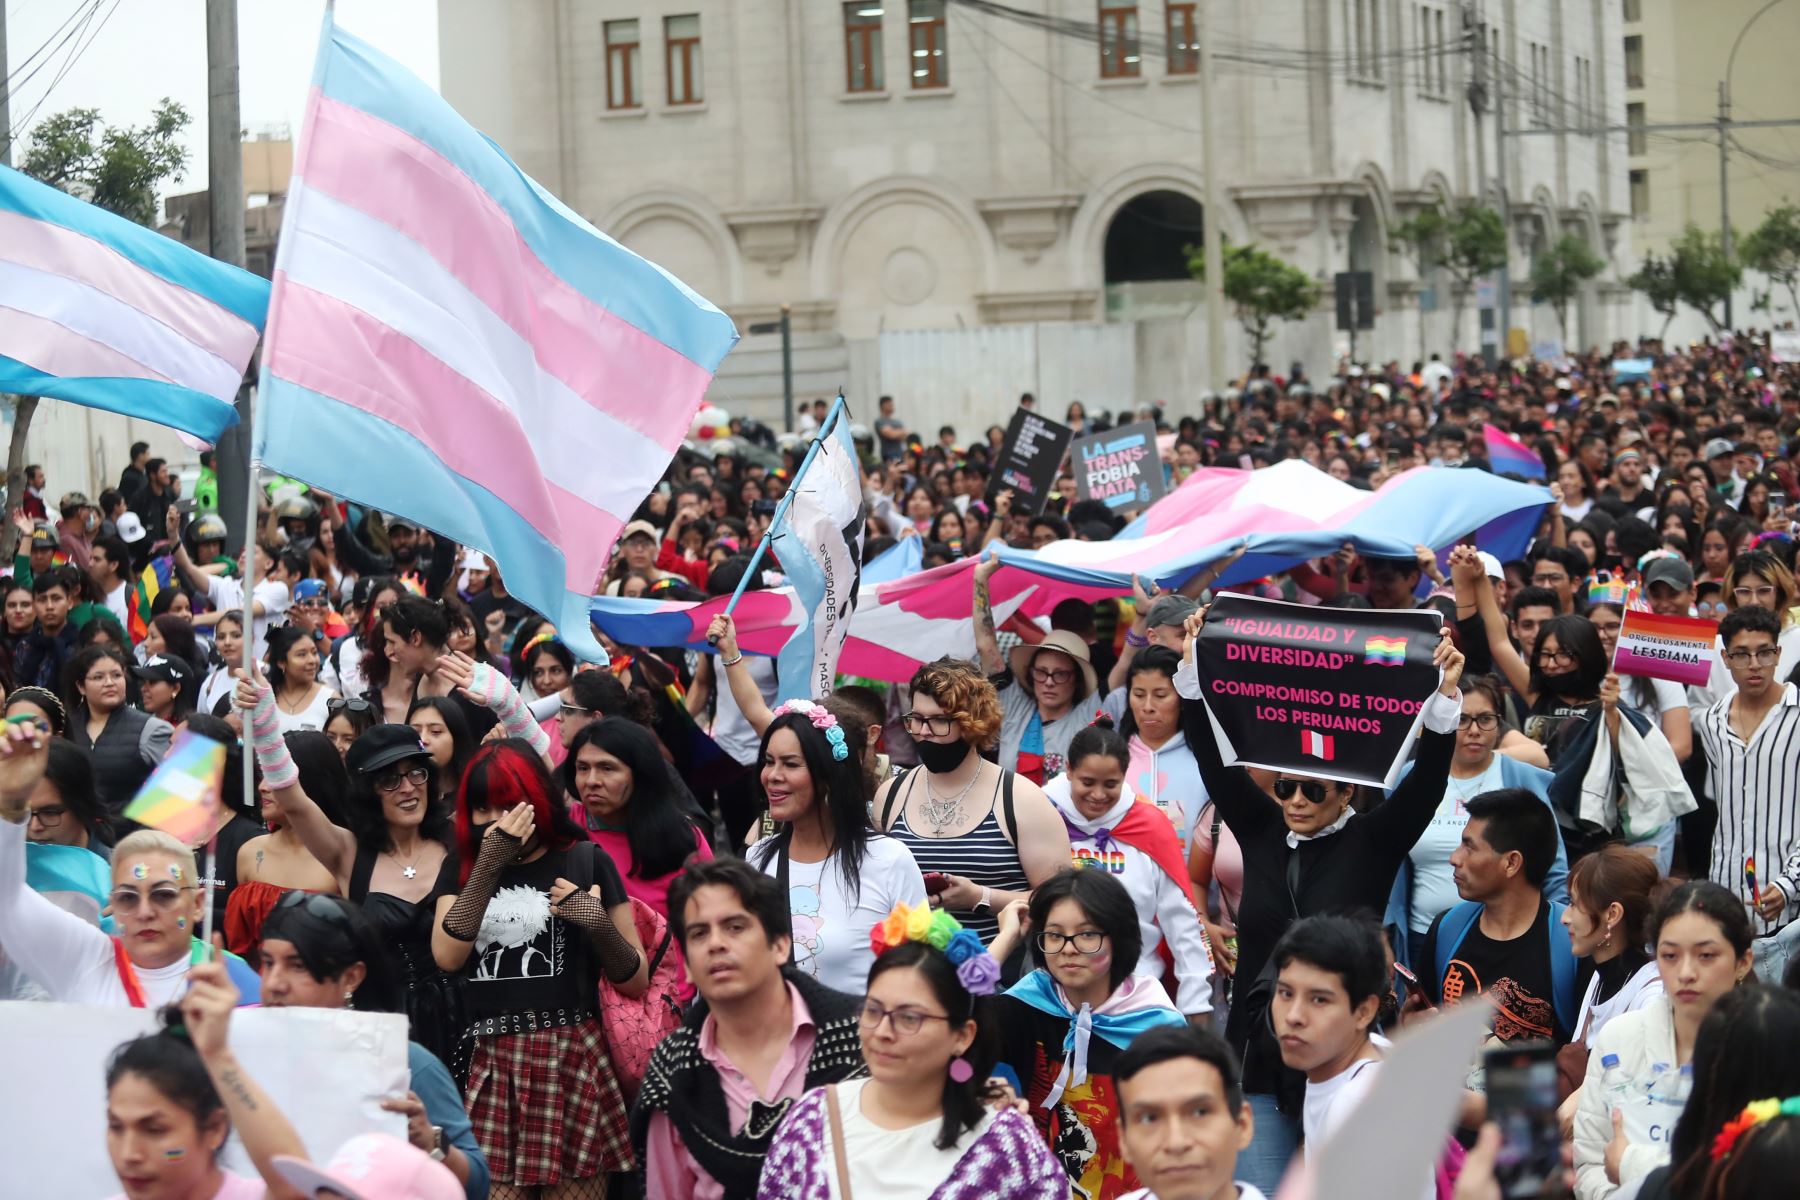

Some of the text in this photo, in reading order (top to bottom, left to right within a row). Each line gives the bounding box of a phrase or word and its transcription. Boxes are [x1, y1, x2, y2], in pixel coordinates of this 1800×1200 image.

[1082, 442, 1105, 461] LA
[1084, 446, 1149, 473] TRANS-
[1086, 462, 1141, 488] FOBIA
[1089, 478, 1137, 500] MATA
[819, 543, 836, 621] DIVERSIDADES
[1225, 617, 1357, 644] “IGUALDAD Y
[1629, 633, 1708, 650] ORGULLOSAMENTE
[1226, 643, 1354, 670] DIVERSIDAD”
[1631, 645, 1699, 664] LESBIANA
[1212, 679, 1423, 716] COMPROMISO DE TODOS
[1256, 705, 1382, 735] LOS PERUANOS
[1649, 1124, 1671, 1143] CI
